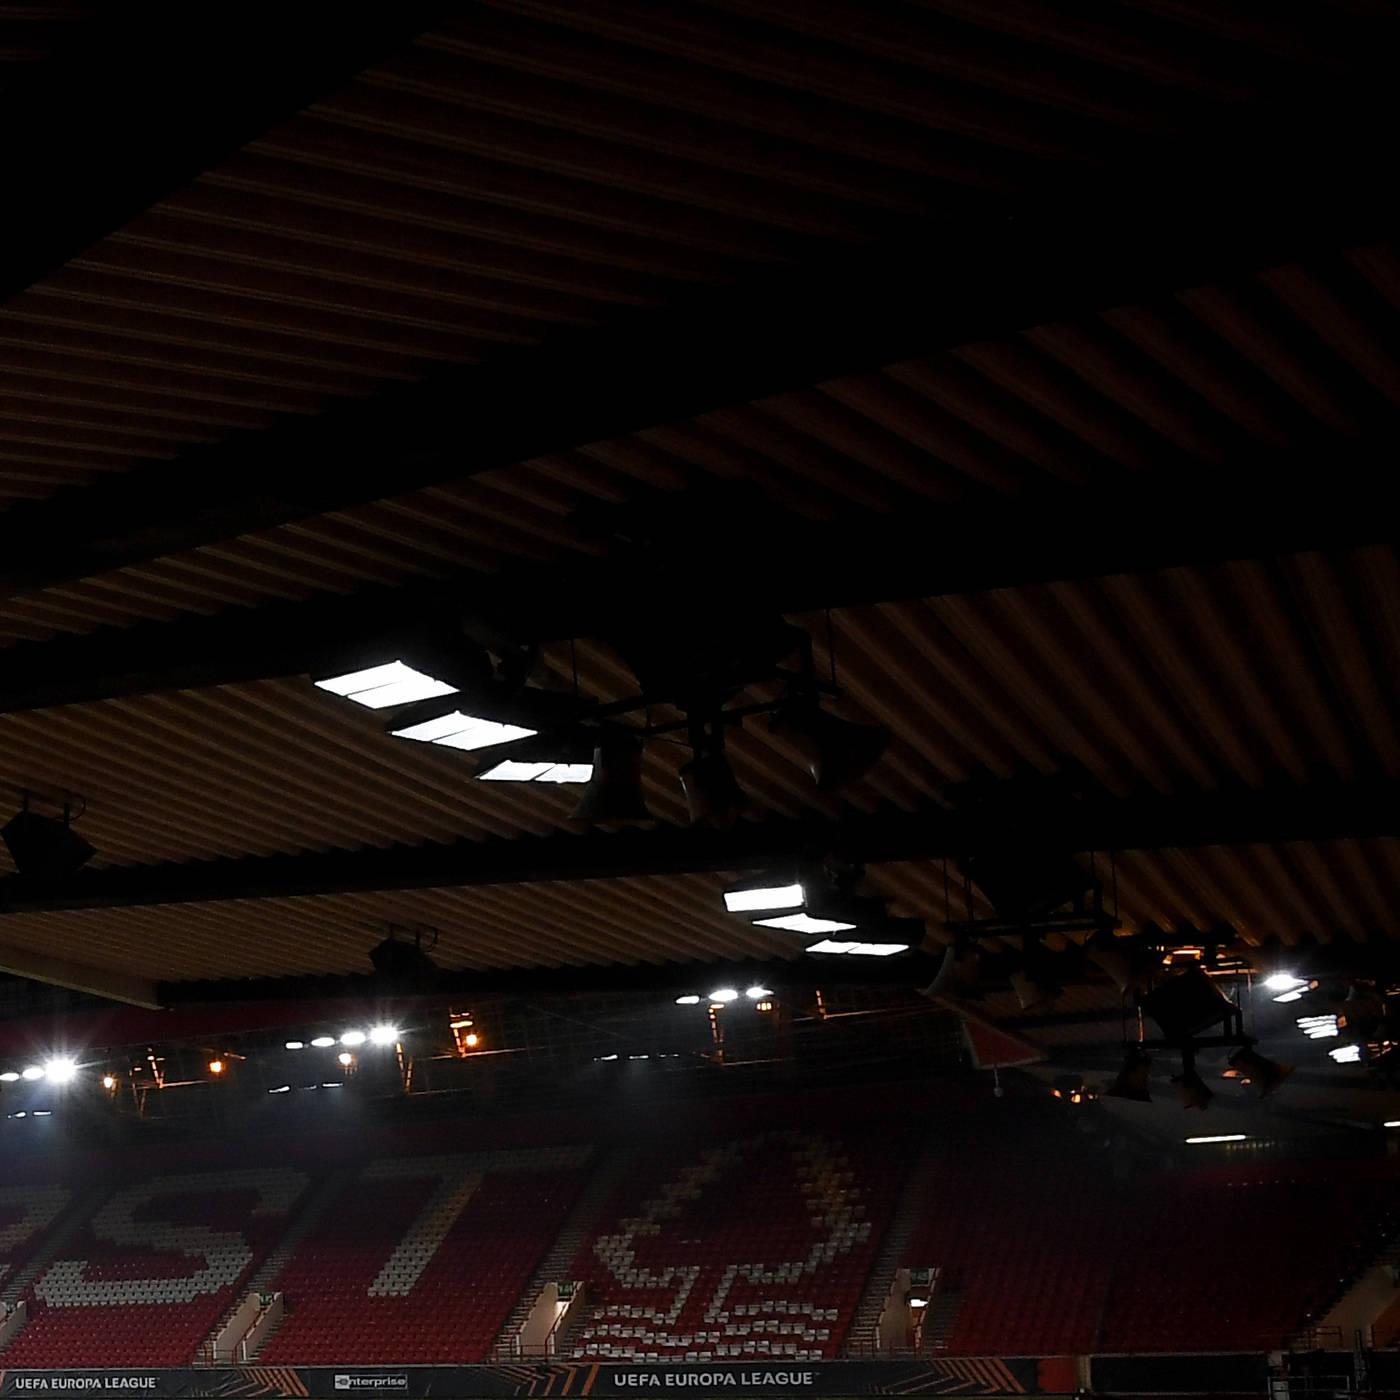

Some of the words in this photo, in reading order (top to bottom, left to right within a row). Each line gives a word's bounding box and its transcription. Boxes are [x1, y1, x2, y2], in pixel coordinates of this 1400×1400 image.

[15, 1379, 48, 1389] UEFA
[51, 1378, 101, 1389] EUROPA
[104, 1377, 155, 1388] LEAGUE
[614, 1373, 660, 1386] UEFA
[665, 1372, 736, 1386] EUROPA
[741, 1371, 812, 1385] LEAGUE
